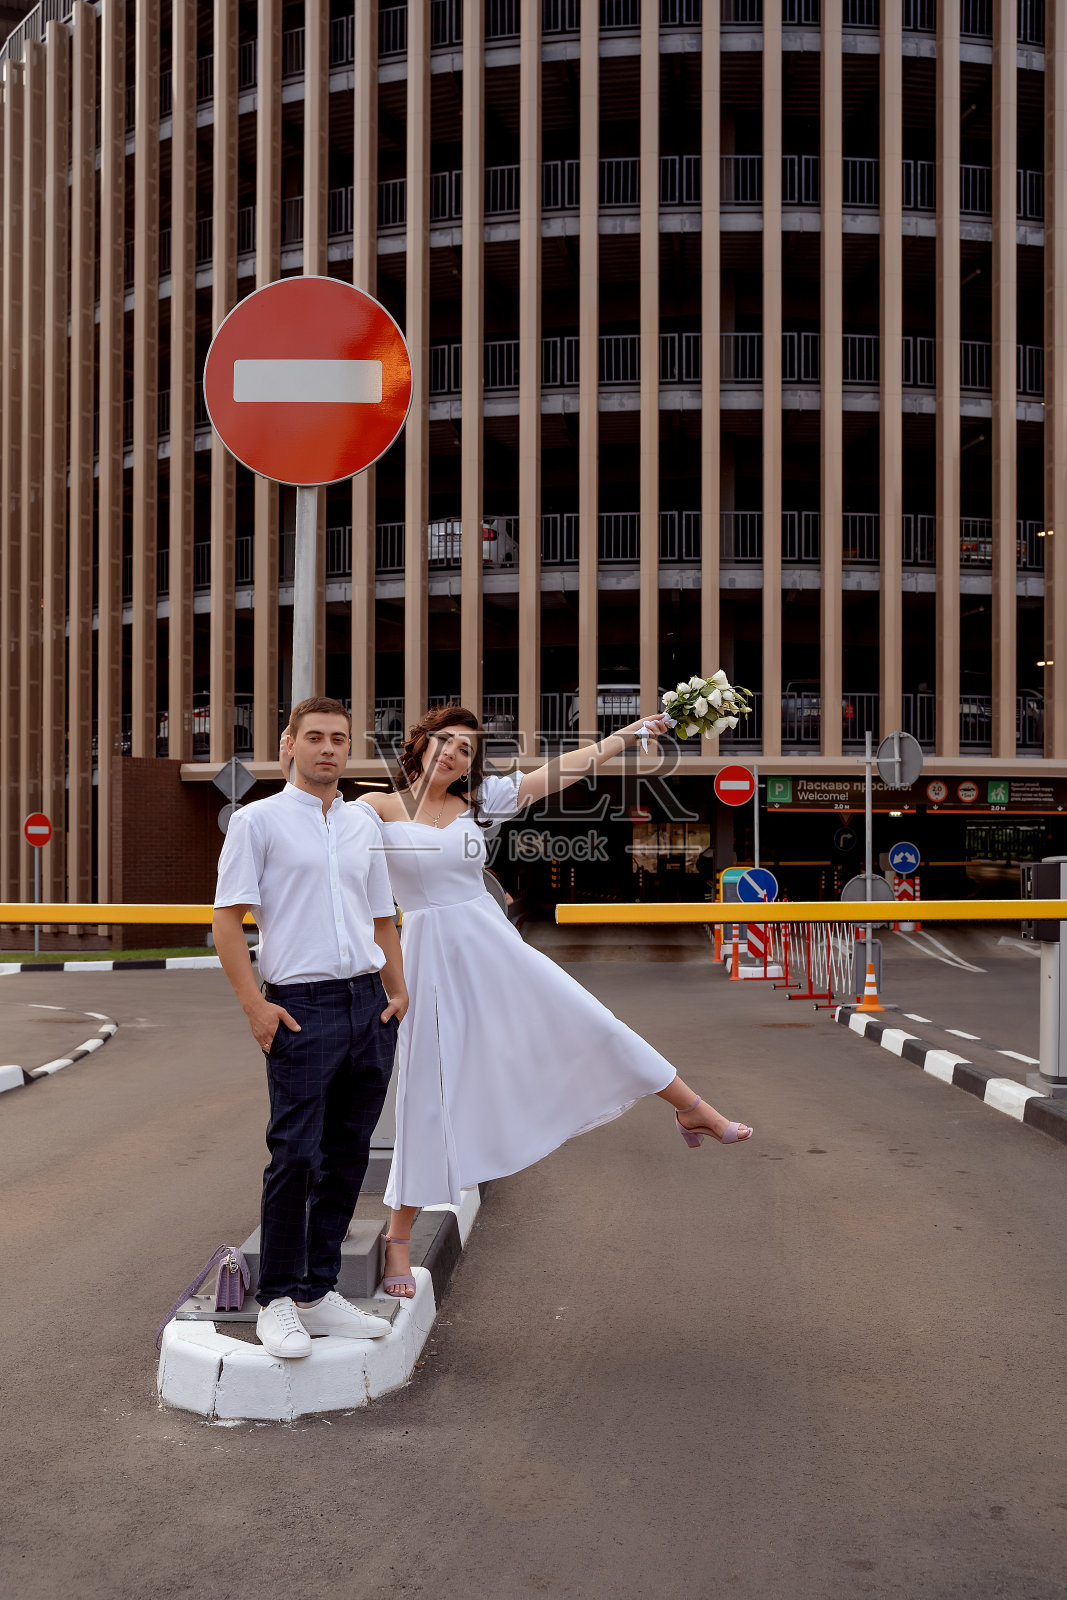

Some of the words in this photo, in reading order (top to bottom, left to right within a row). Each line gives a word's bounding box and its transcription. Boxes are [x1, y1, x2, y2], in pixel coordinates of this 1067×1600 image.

[775, 783, 784, 795] P
[797, 780, 850, 791] Ласкаво
[797, 791, 849, 801] Welcome!
